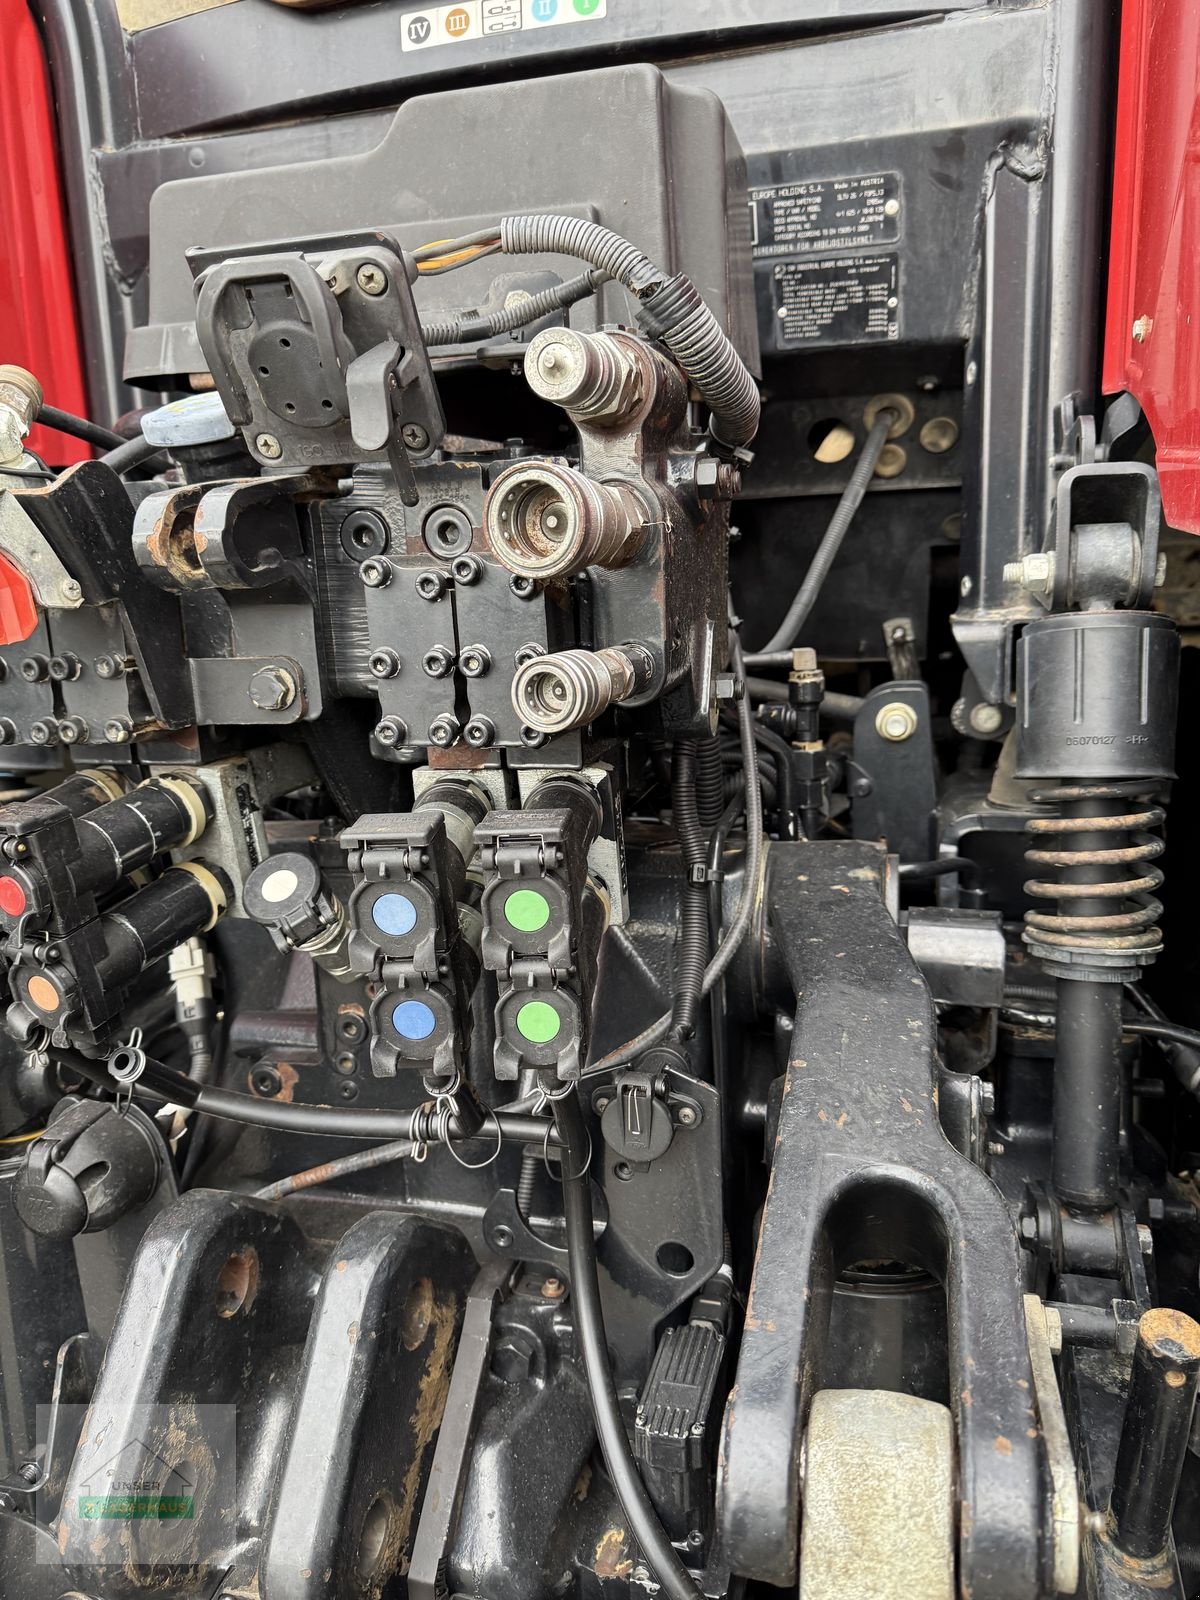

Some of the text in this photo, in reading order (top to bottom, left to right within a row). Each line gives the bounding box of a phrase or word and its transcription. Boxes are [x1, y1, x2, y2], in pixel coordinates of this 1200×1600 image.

[410, 21, 429, 40] IV
[448, 14, 467, 31] III
[860, 177, 884, 187] AUSTRIA
[752, 189, 776, 200] EUROPE
[778, 186, 807, 198] HOLDING
